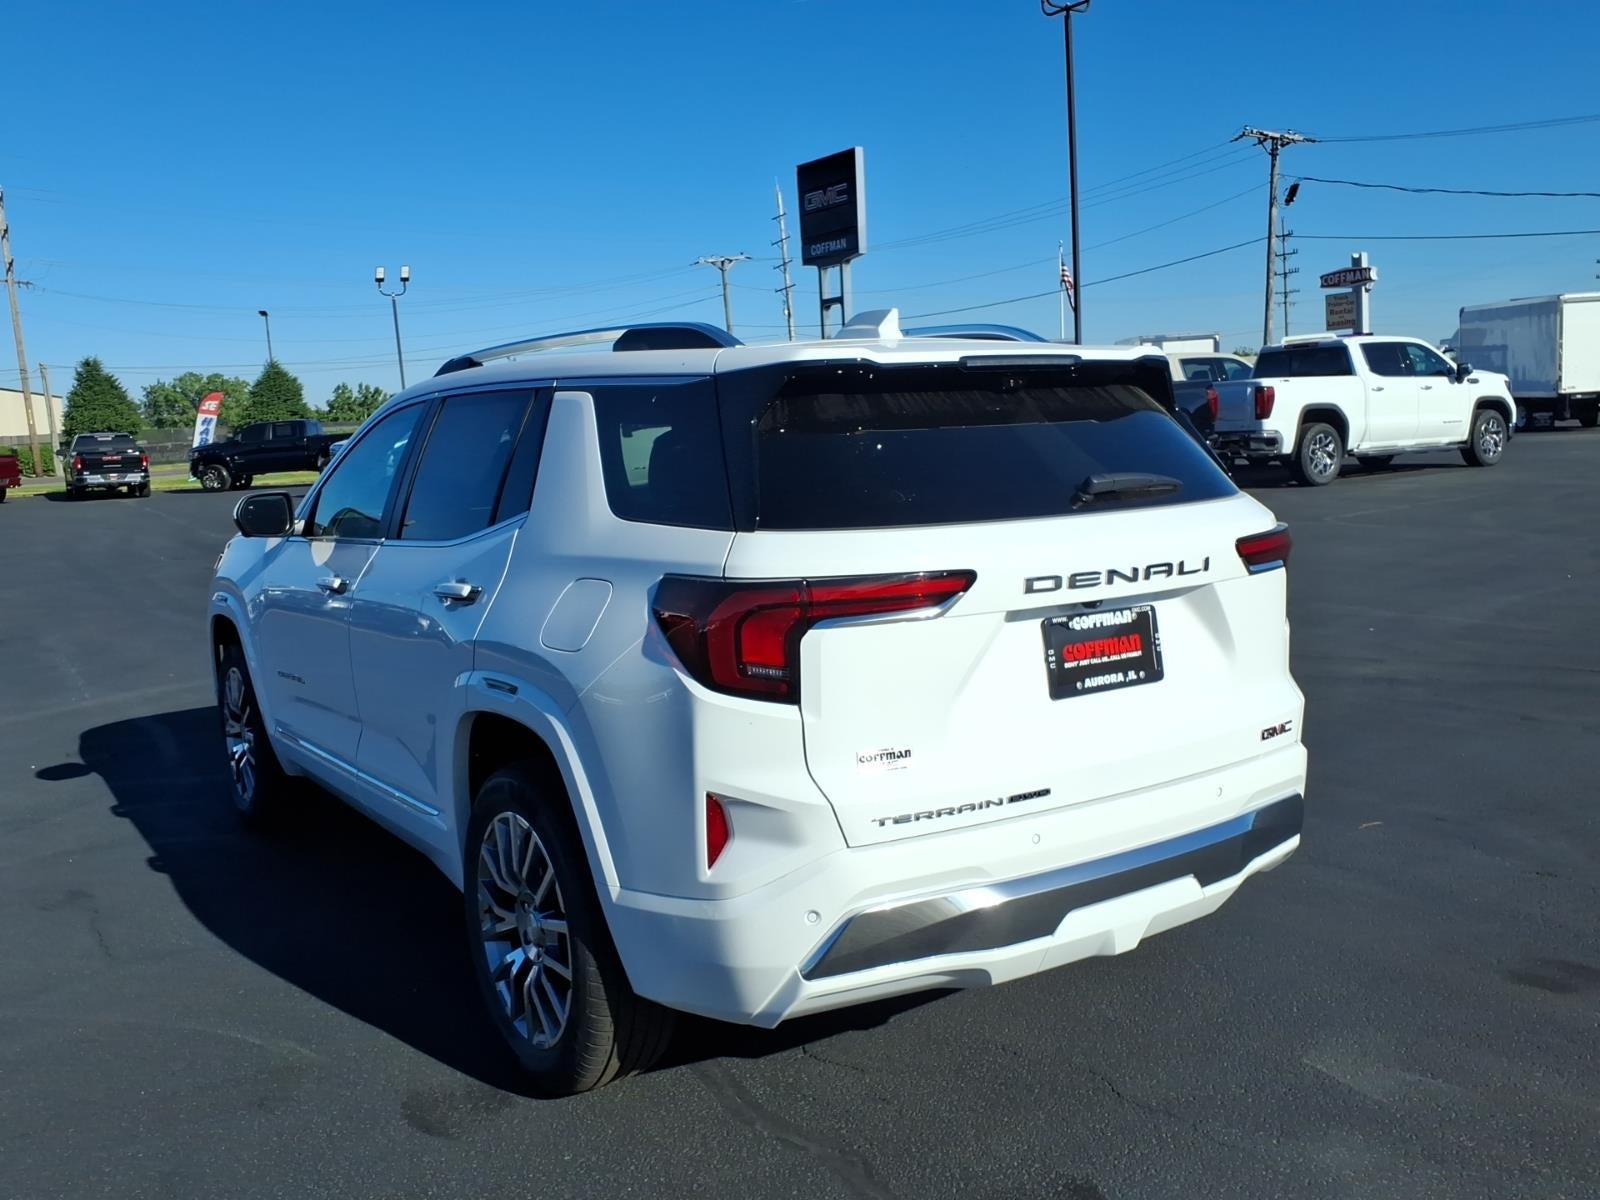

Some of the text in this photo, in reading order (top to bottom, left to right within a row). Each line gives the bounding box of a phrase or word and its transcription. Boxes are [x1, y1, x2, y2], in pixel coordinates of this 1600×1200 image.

[804, 183, 848, 211] GMC
[811, 238, 847, 256] COFFMAN
[1322, 268, 1370, 286] COFFMAN
[1023, 556, 1210, 594] DENALI
[1062, 634, 1142, 663] COFFMAN
[1084, 672, 1124, 688] AURORA
[1261, 720, 1292, 740] GMC
[872, 797, 1004, 827] TERRAIN
